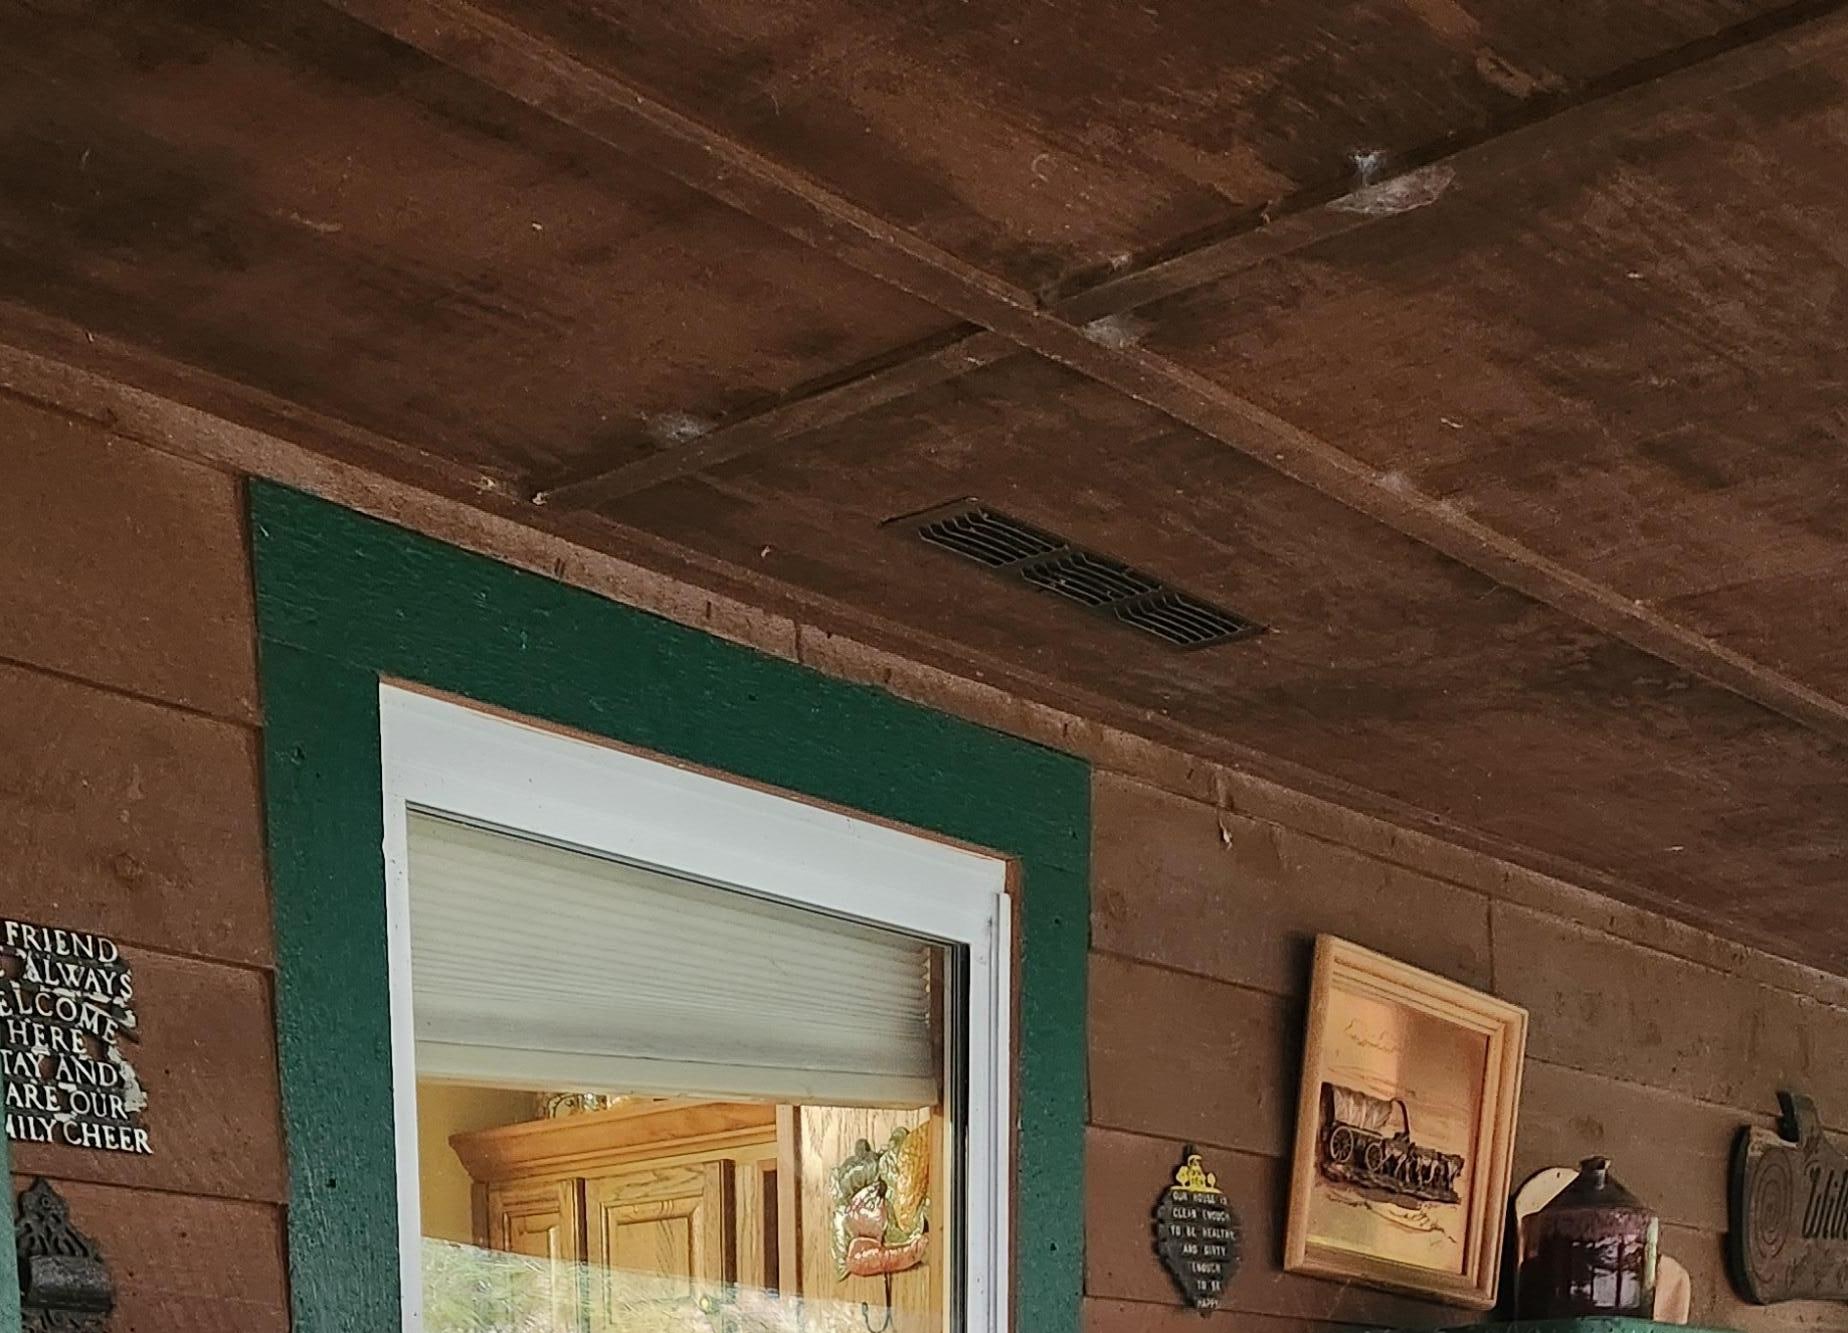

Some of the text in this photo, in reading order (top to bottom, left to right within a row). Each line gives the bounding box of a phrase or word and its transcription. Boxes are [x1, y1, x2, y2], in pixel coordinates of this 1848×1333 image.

[4, 921, 118, 963] FRIEND
[23, 951, 133, 999] ALWAYS
[0, 987, 119, 1044] ELCOME
[7, 1019, 87, 1053] HERE
[0, 1048, 118, 1087] TAY AND
[5, 1081, 128, 1119] ARE OUR
[63, 1120, 153, 1154] CHEER
[1172, 1208, 1197, 1219] CLEAN
